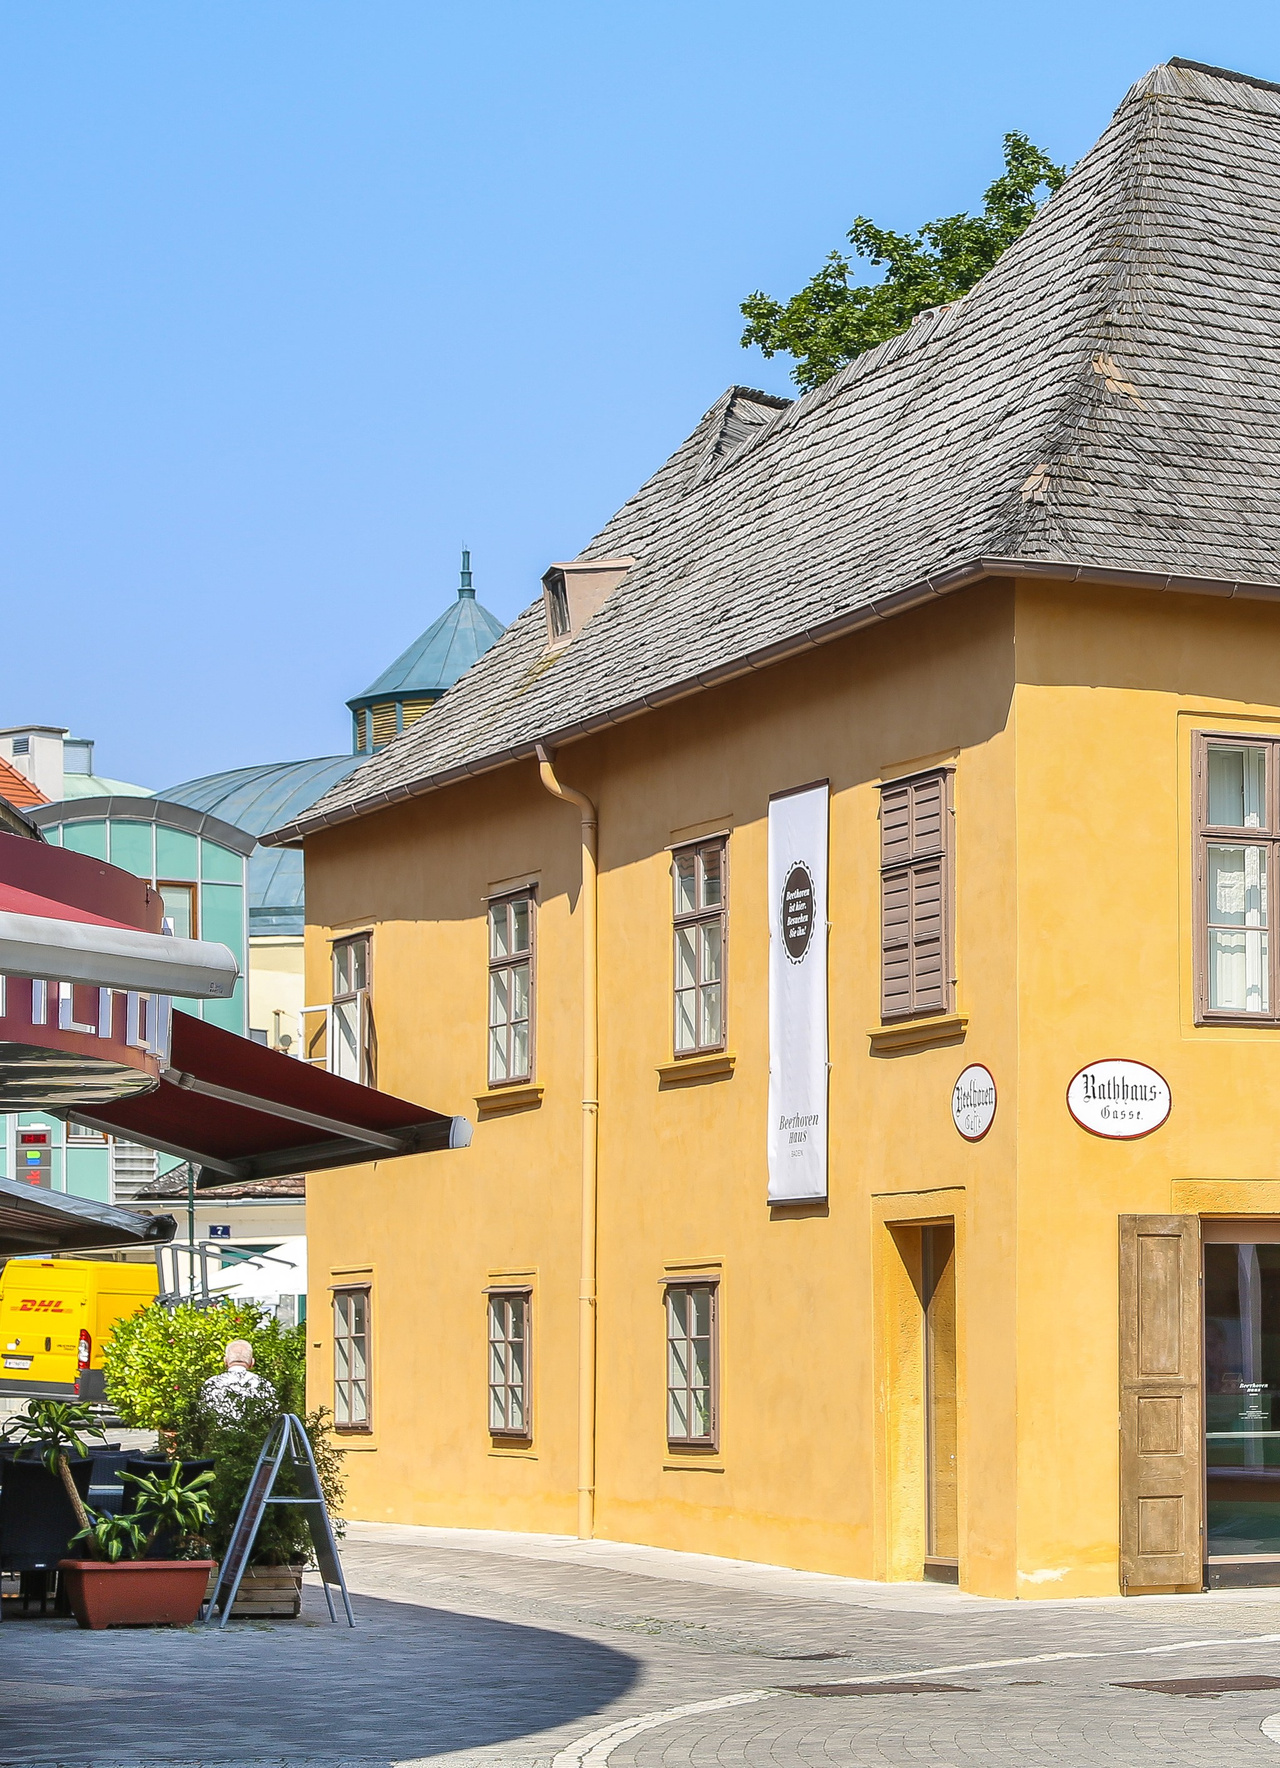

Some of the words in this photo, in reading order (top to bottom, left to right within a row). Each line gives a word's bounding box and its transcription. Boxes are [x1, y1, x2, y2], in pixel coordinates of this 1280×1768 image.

[786, 888, 810, 901] Beethoven
[779, 1112, 819, 1131] Beethoven
[20, 1299, 64, 1313] DHL
